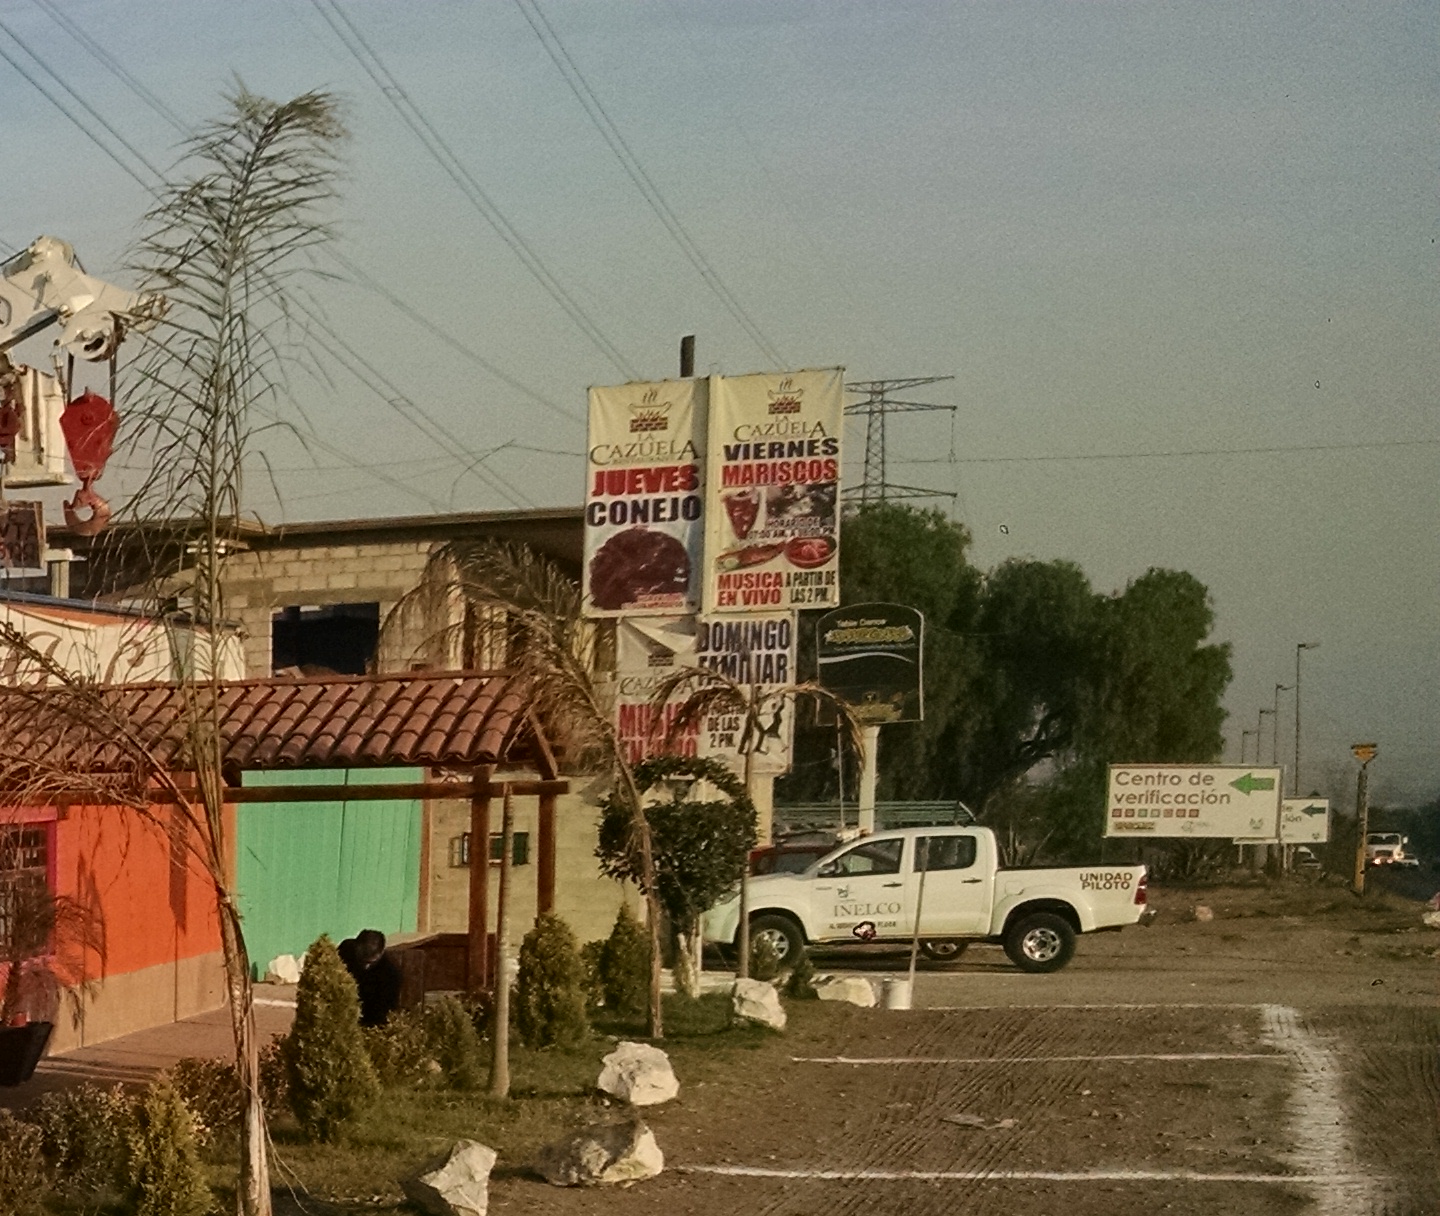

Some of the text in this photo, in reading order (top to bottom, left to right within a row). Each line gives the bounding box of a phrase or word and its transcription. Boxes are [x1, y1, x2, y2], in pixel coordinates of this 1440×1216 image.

[733, 420, 827, 442] CAZUELA
[589, 439, 701, 466] CAZUELA
[723, 437, 839, 461] VIERNES
[591, 464, 700, 496] JUEVES
[722, 458, 838, 486] MARISCOS
[586, 495, 702, 526] CONEJO
[717, 571, 784, 590] MUSICA
[785, 570, 836, 588] A PARTIR DE
[717, 588, 782, 606] EN VIVO
[790, 587, 806, 604] LAS
[806, 587, 813, 602] 2
[697, 618, 791, 652] DOMINGO
[707, 716, 741, 732] DE LAS
[709, 733, 717, 748] 2
[1114, 771, 1215, 786] Centro de
[1114, 788, 1231, 806] verificación
[1079, 872, 1133, 882] UNIDAD
[1081, 881, 1130, 890] PILOTO
[833, 901, 901, 917] INELCO
